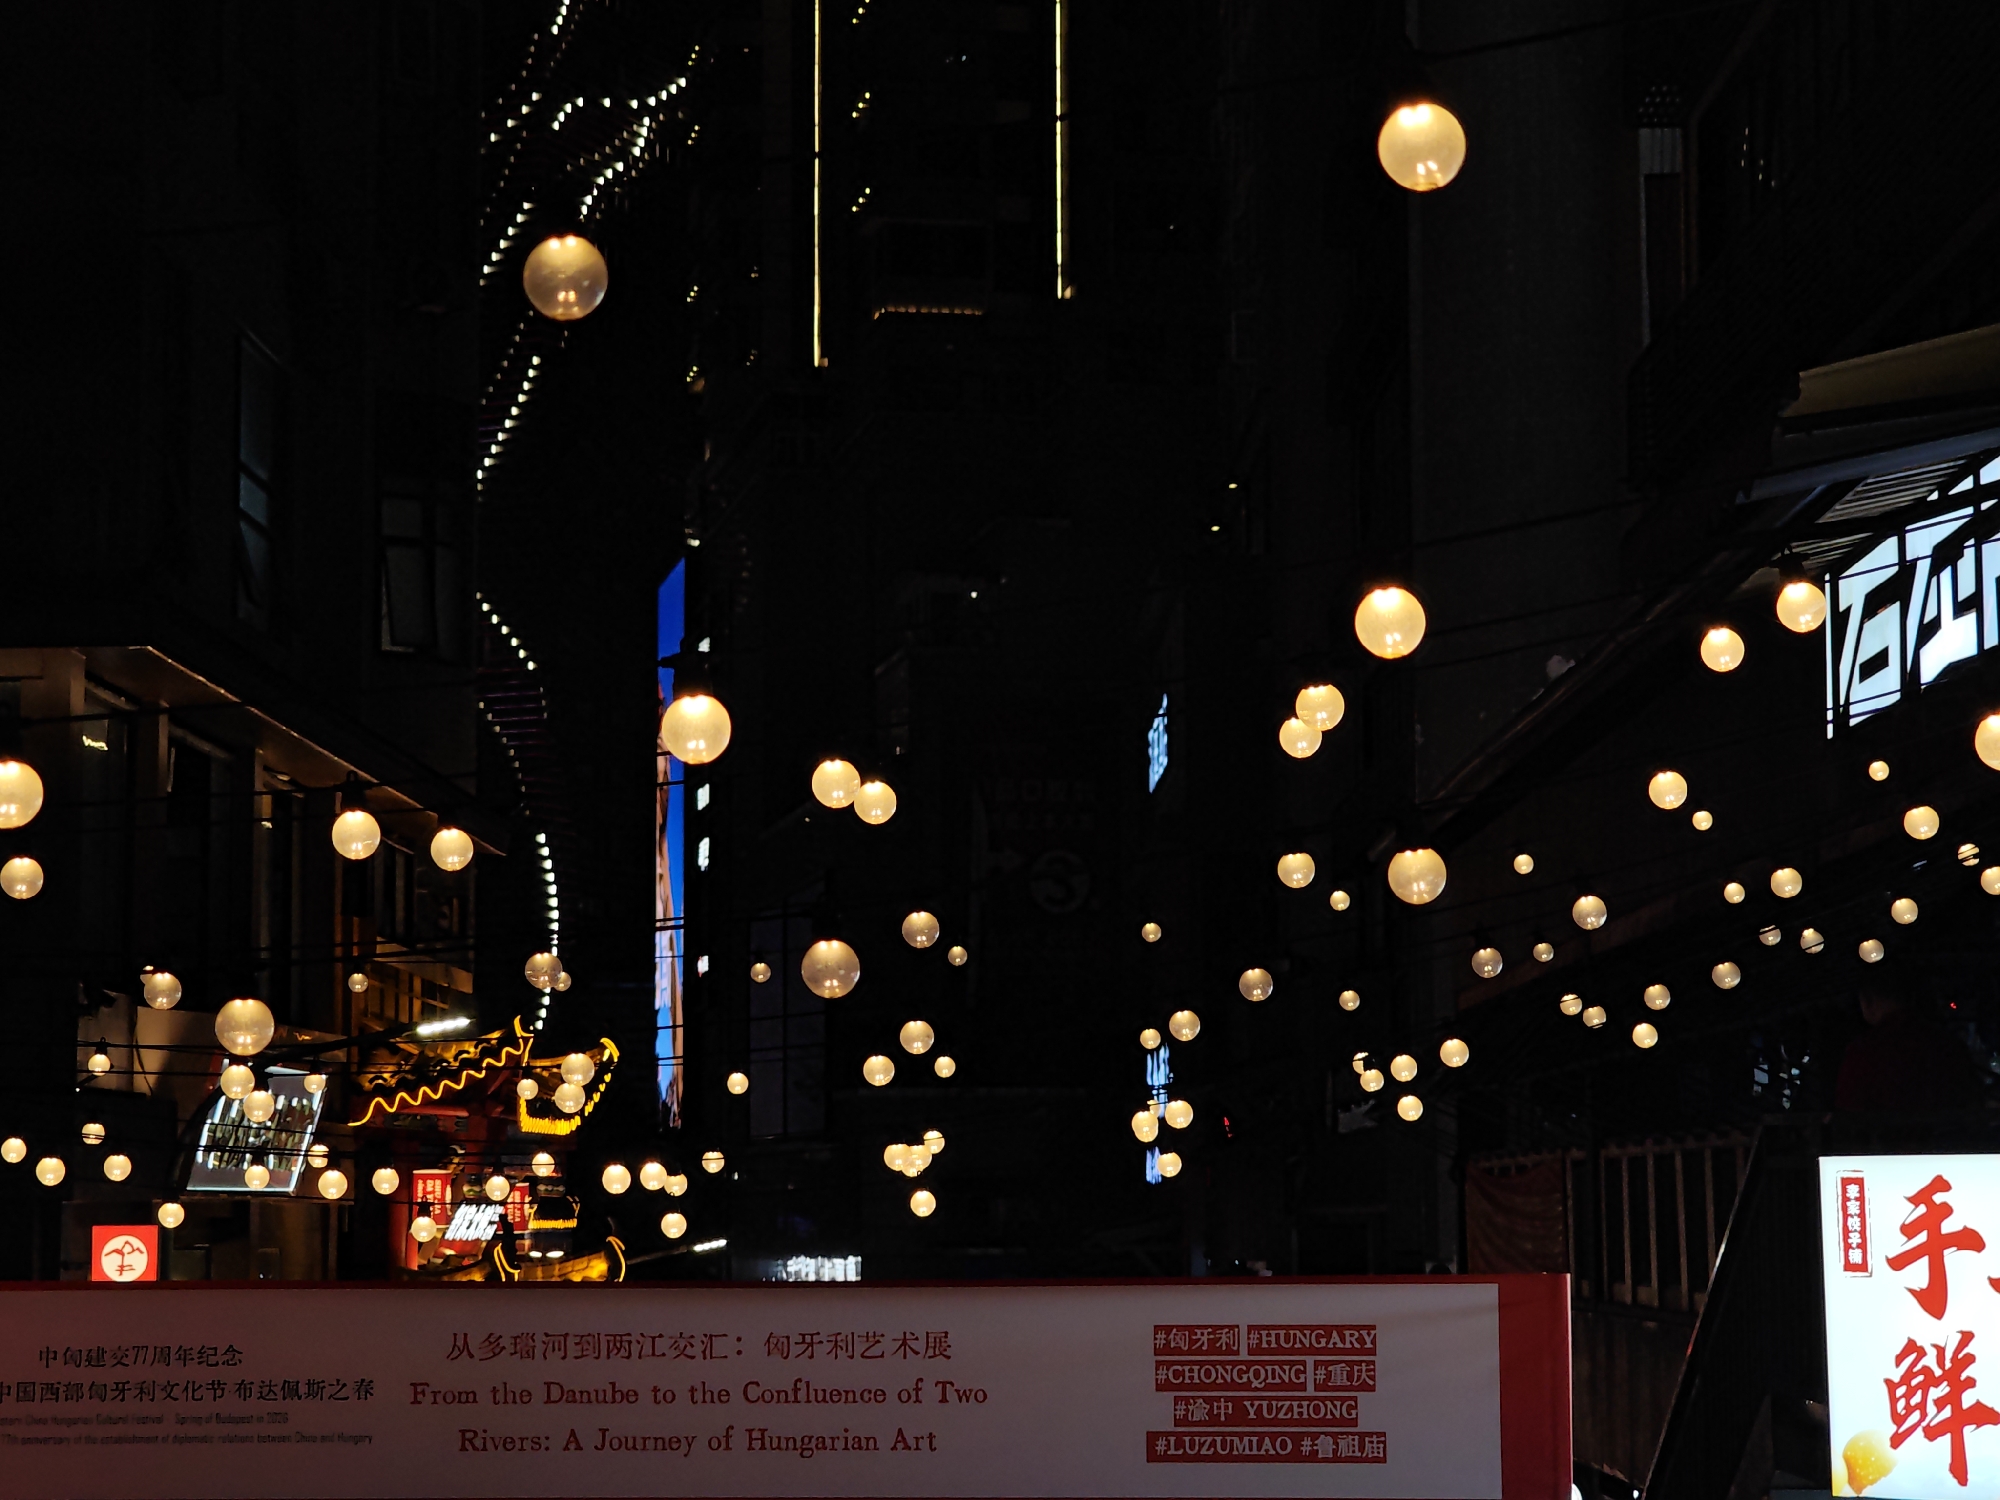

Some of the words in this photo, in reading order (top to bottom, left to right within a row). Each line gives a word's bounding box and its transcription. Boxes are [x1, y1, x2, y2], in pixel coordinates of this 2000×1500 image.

[1885, 1174, 2000, 1320] 手
[446, 1331, 952, 1362] 从多瑙河到两江交汇：匈牙利艺术展
[1154, 1327, 1239, 1351] #匈牙利
[1247, 1329, 1377, 1349] #HUNGARY
[39, 1345, 244, 1369] 中匈建交77周年纪念
[1156, 1364, 1307, 1389] #CHONGQING
[1314, 1363, 1375, 1387] #重庆
[410, 1382, 478, 1405] From
[490, 1381, 532, 1405] the
[544, 1381, 639, 1404] Danube
[651, 1385, 676, 1405] to
[688, 1381, 730, 1405] the
[743, 1379, 886, 1404] Confluence
[897, 1378, 924, 1404] of
[935, 1381, 987, 1404] Two
[1174, 1398, 1233, 1422] #渝中
[1243, 1400, 1358, 1419] YUZHONG
[1883, 1330, 2000, 1487] 鲜
[458, 1429, 550, 1452] Rivers:
[562, 1429, 583, 1451] A
[594, 1428, 697, 1458] Journey
[708, 1425, 734, 1452] of
[745, 1428, 879, 1458] Hungarian
[890, 1428, 937, 1452] Art
[1155, 1436, 1293, 1456] #LUZUMIAO
[1300, 1434, 1385, 1458] #鲁祖庙
